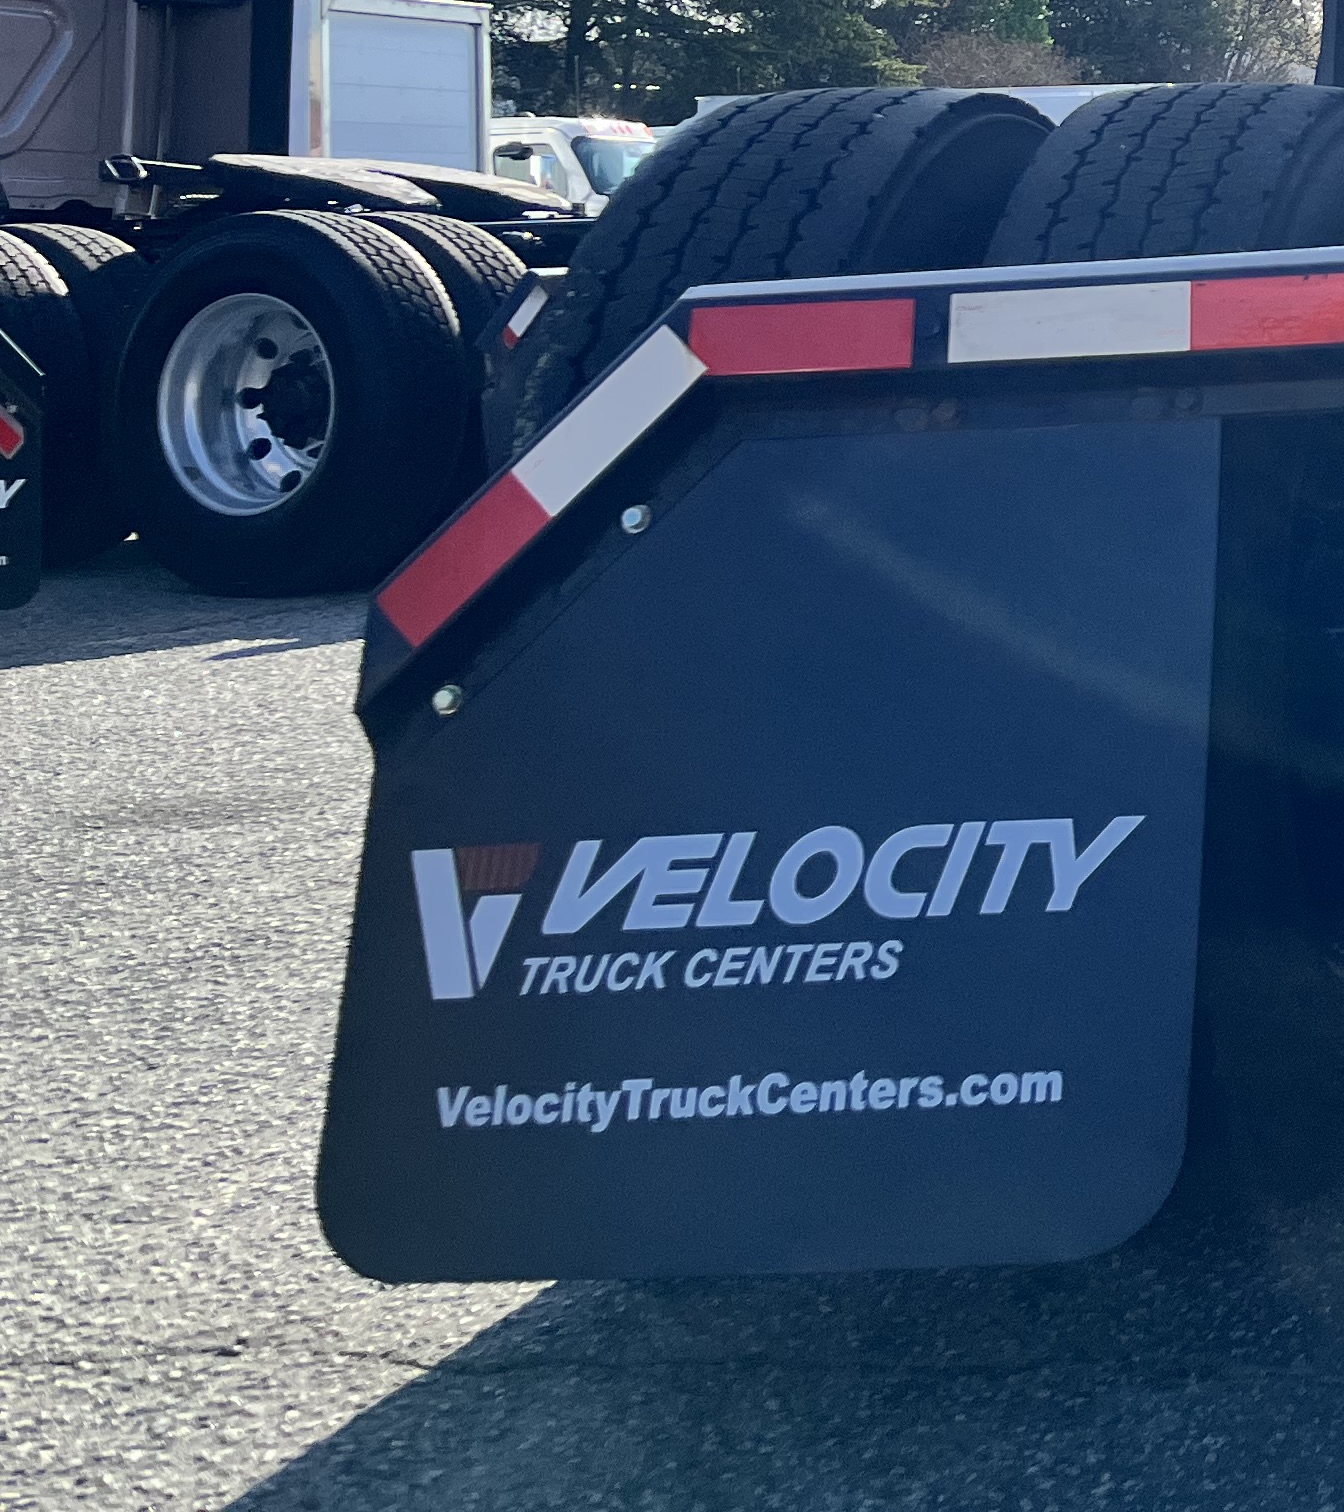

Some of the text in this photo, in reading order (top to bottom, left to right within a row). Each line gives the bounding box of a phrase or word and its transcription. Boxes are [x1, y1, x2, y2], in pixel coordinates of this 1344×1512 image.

[542, 815, 1146, 934] VELOCITY
[520, 940, 903, 995] TRUCK CENTERS
[438, 1070, 1062, 1132] VelocityTruckCenters.com
